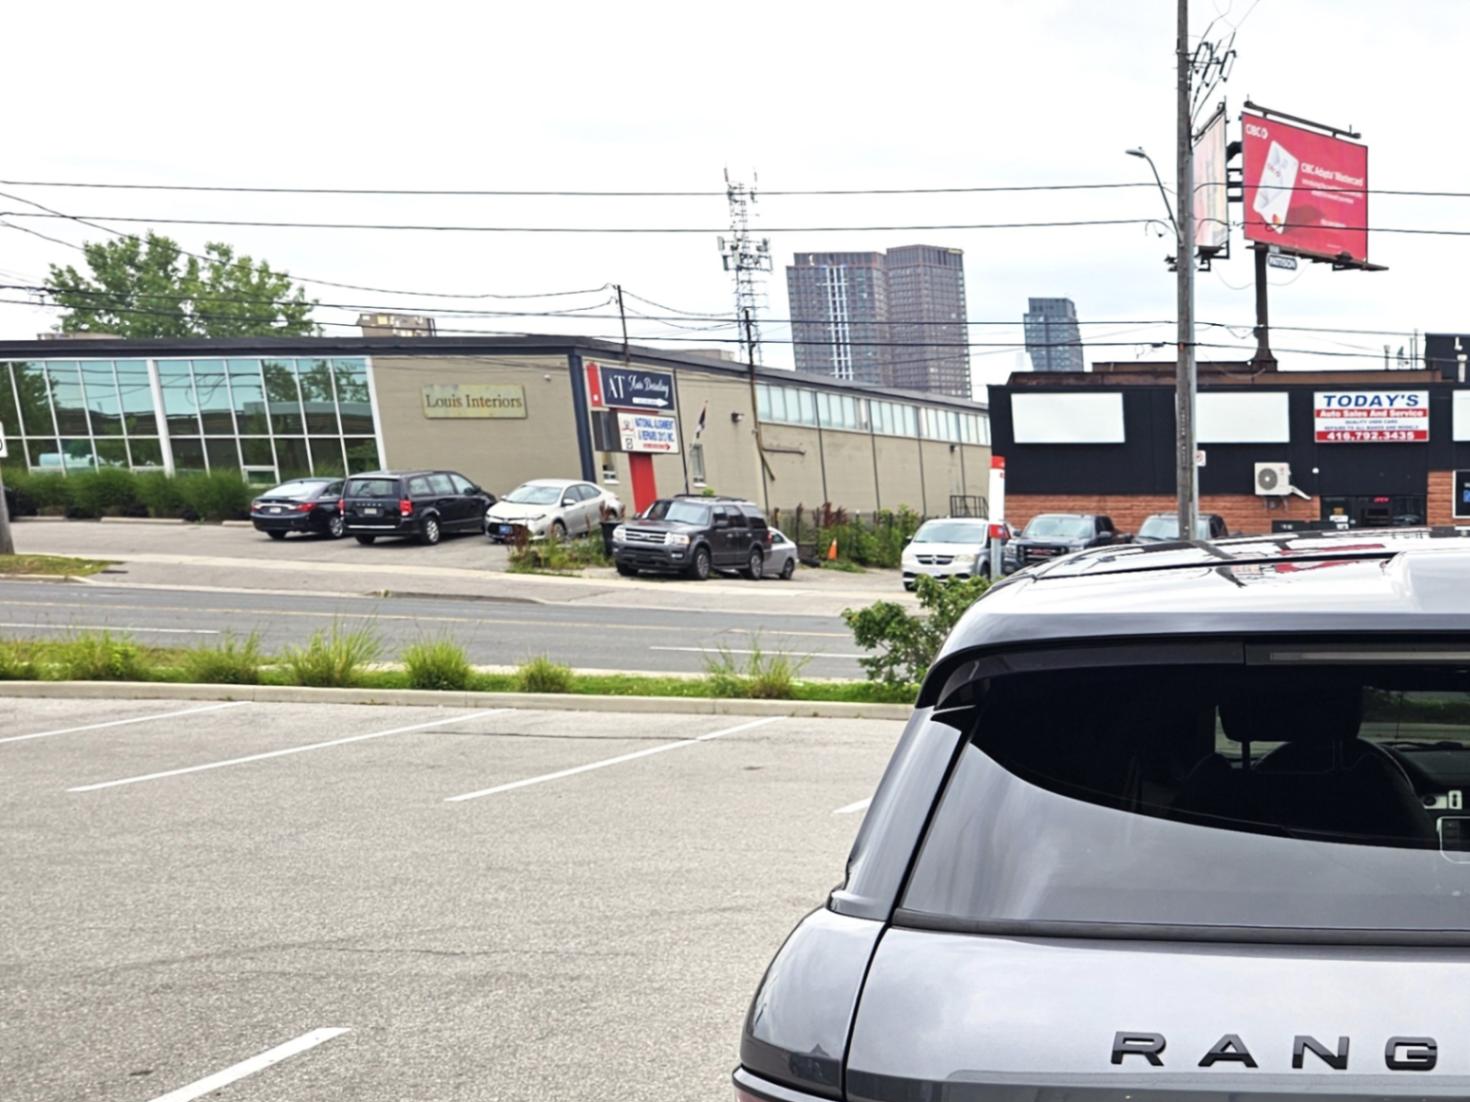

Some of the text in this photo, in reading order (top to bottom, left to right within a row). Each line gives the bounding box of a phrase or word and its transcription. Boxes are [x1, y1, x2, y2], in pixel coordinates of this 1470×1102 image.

[425, 394, 522, 408] Louis Interiors
[1323, 394, 1419, 407] TODAY'S
[1320, 409, 1424, 418] Auto Sales And Service
